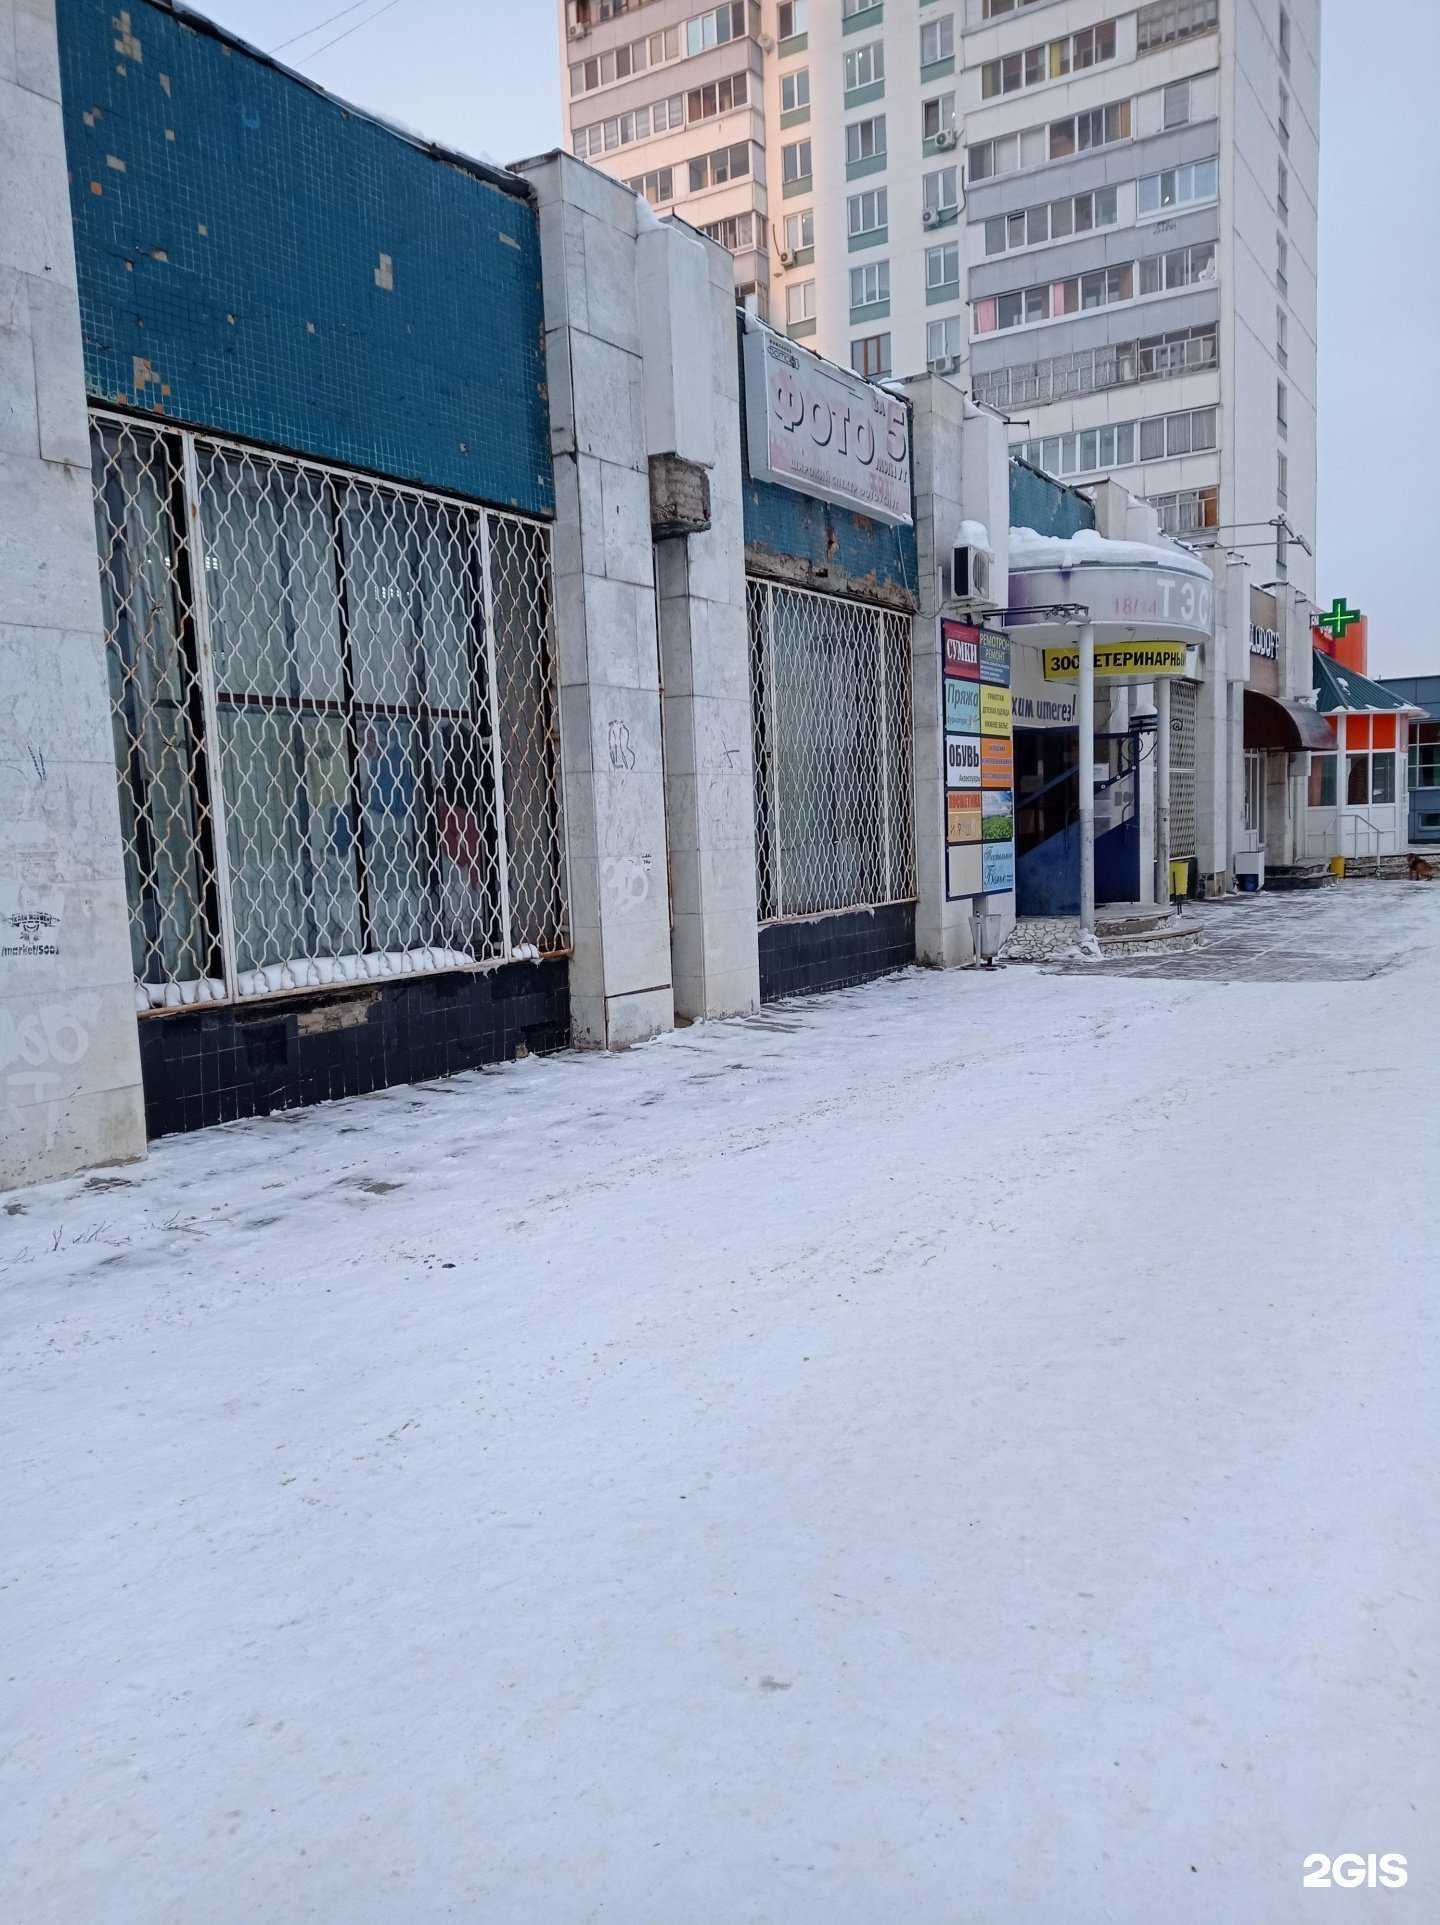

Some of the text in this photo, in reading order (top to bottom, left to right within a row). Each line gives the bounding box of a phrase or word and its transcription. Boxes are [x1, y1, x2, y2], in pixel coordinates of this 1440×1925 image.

[946, 638, 978, 664] СУМКИ
[947, 683, 979, 709] Пряжа
[949, 743, 980, 767] ОБУВЬ
